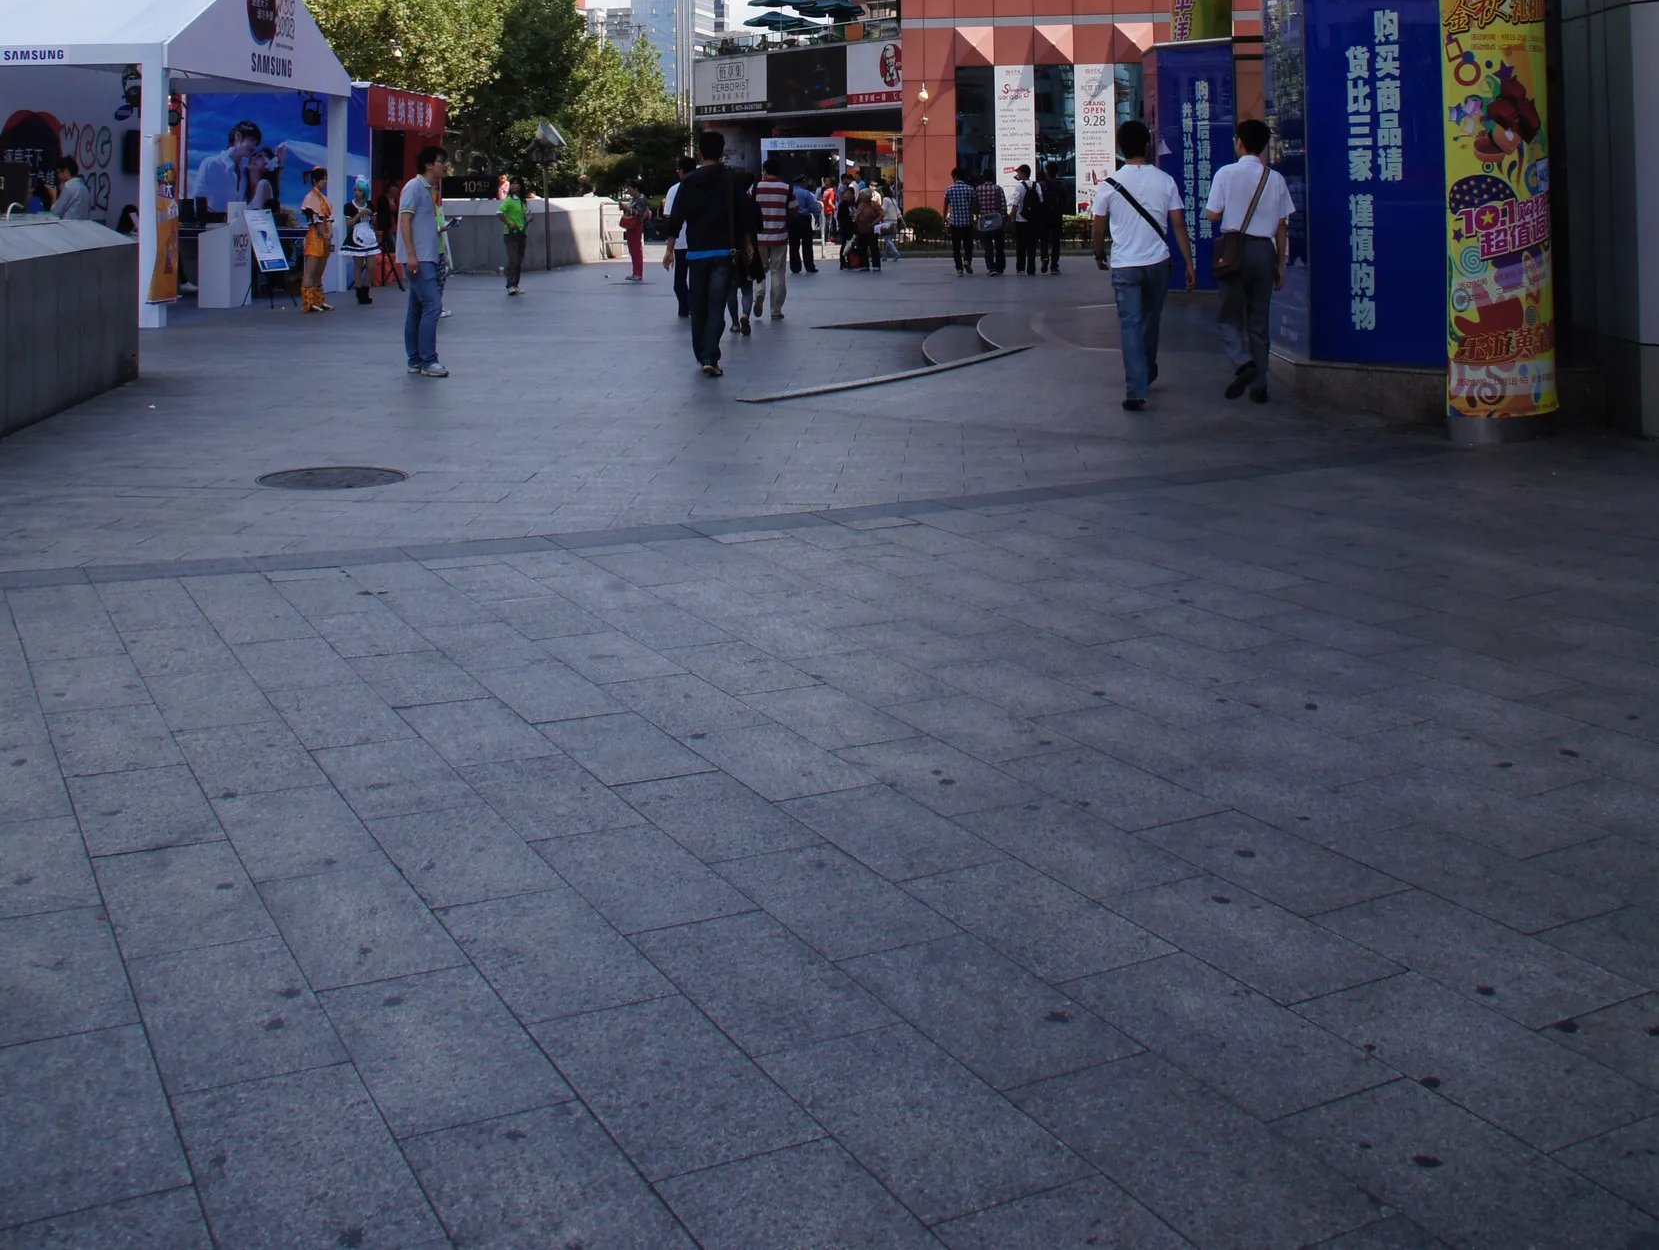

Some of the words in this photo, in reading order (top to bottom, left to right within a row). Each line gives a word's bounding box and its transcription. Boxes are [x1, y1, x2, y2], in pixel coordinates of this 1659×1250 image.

[3, 49, 65, 61] SAMSUNG
[251, 52, 292, 78] SAMSUNG
[711, 79, 750, 92] HERBORIST
[1373, 9, 1403, 182] 购买商品请
[387, 95, 433, 128] 维纳斯婚纱
[1083, 115, 1106, 127] 9.28
[1346, 45, 1373, 182] 货比三家
[770, 139, 795, 149] 博士伦
[232, 234, 249, 248] WCG
[1349, 193, 1376, 331] 谨慎购物
